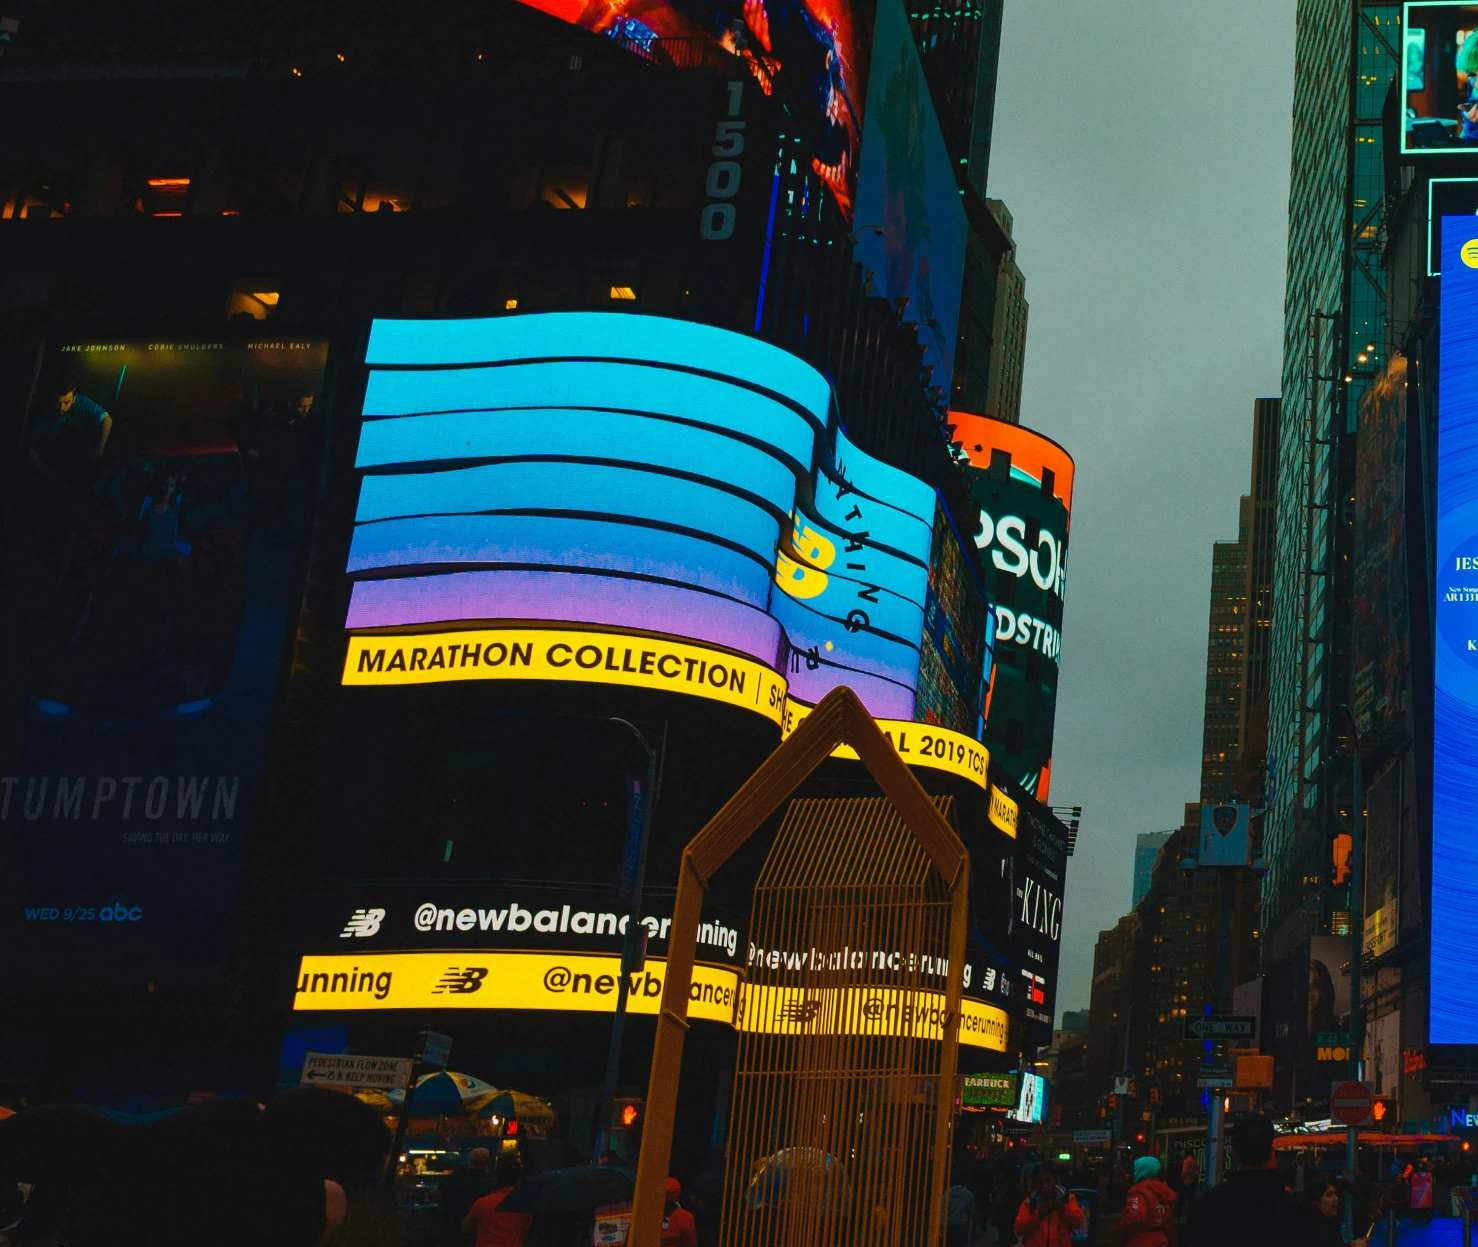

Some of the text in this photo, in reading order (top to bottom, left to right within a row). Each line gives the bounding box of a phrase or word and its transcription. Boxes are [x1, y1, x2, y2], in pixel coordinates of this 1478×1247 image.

[85, 343, 126, 352] JOHNSON
[247, 342, 287, 350] MICHAEL
[357, 642, 534, 672] MARATHON
[546, 642, 747, 694] COLLECTION
[919, 735, 965, 764] 2019
[25, 901, 143, 922] WED 9/25 abc
[1021, 876, 1061, 941] KING
[1195, 1022, 1247, 1033] ONE WAY
[309, 1057, 399, 1072] PEDESTRIAN FLOW ZONE
[346, 1072, 397, 1084] KEEP MOVING
